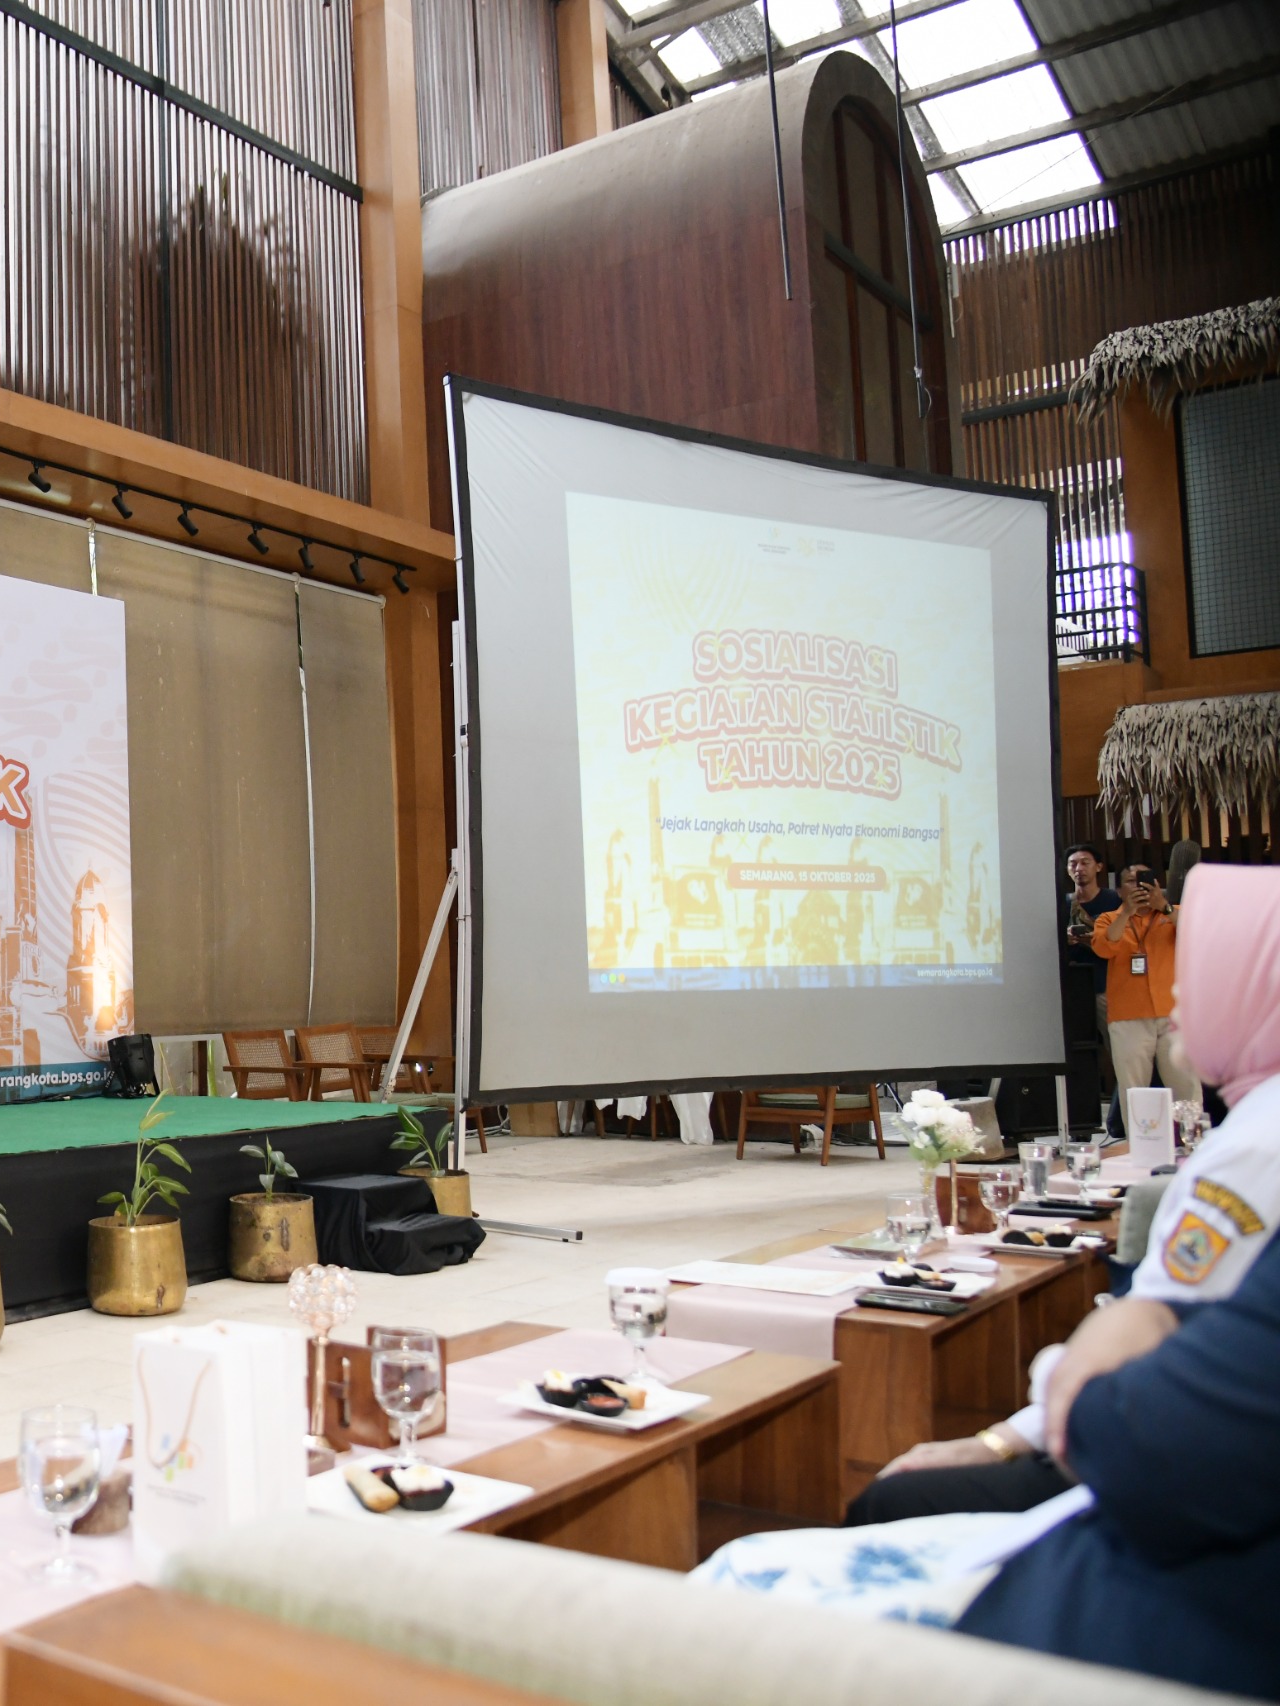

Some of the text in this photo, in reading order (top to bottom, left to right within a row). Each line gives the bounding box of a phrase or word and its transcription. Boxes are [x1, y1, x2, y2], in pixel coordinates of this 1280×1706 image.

[694, 633, 897, 691] SOSIALISASI
[626, 687, 962, 764] KEGIATAN STATISTIK
[699, 742, 899, 792] TAHUN 2025
[694, 818, 746, 835] Langkah
[748, 820, 785, 836] Usaha,
[787, 822, 820, 836] Potret
[821, 823, 853, 838] Nyata
[854, 824, 901, 838] Ekonomi
[739, 870, 876, 883] SEMARANG, 15 OKTOBER 2025
